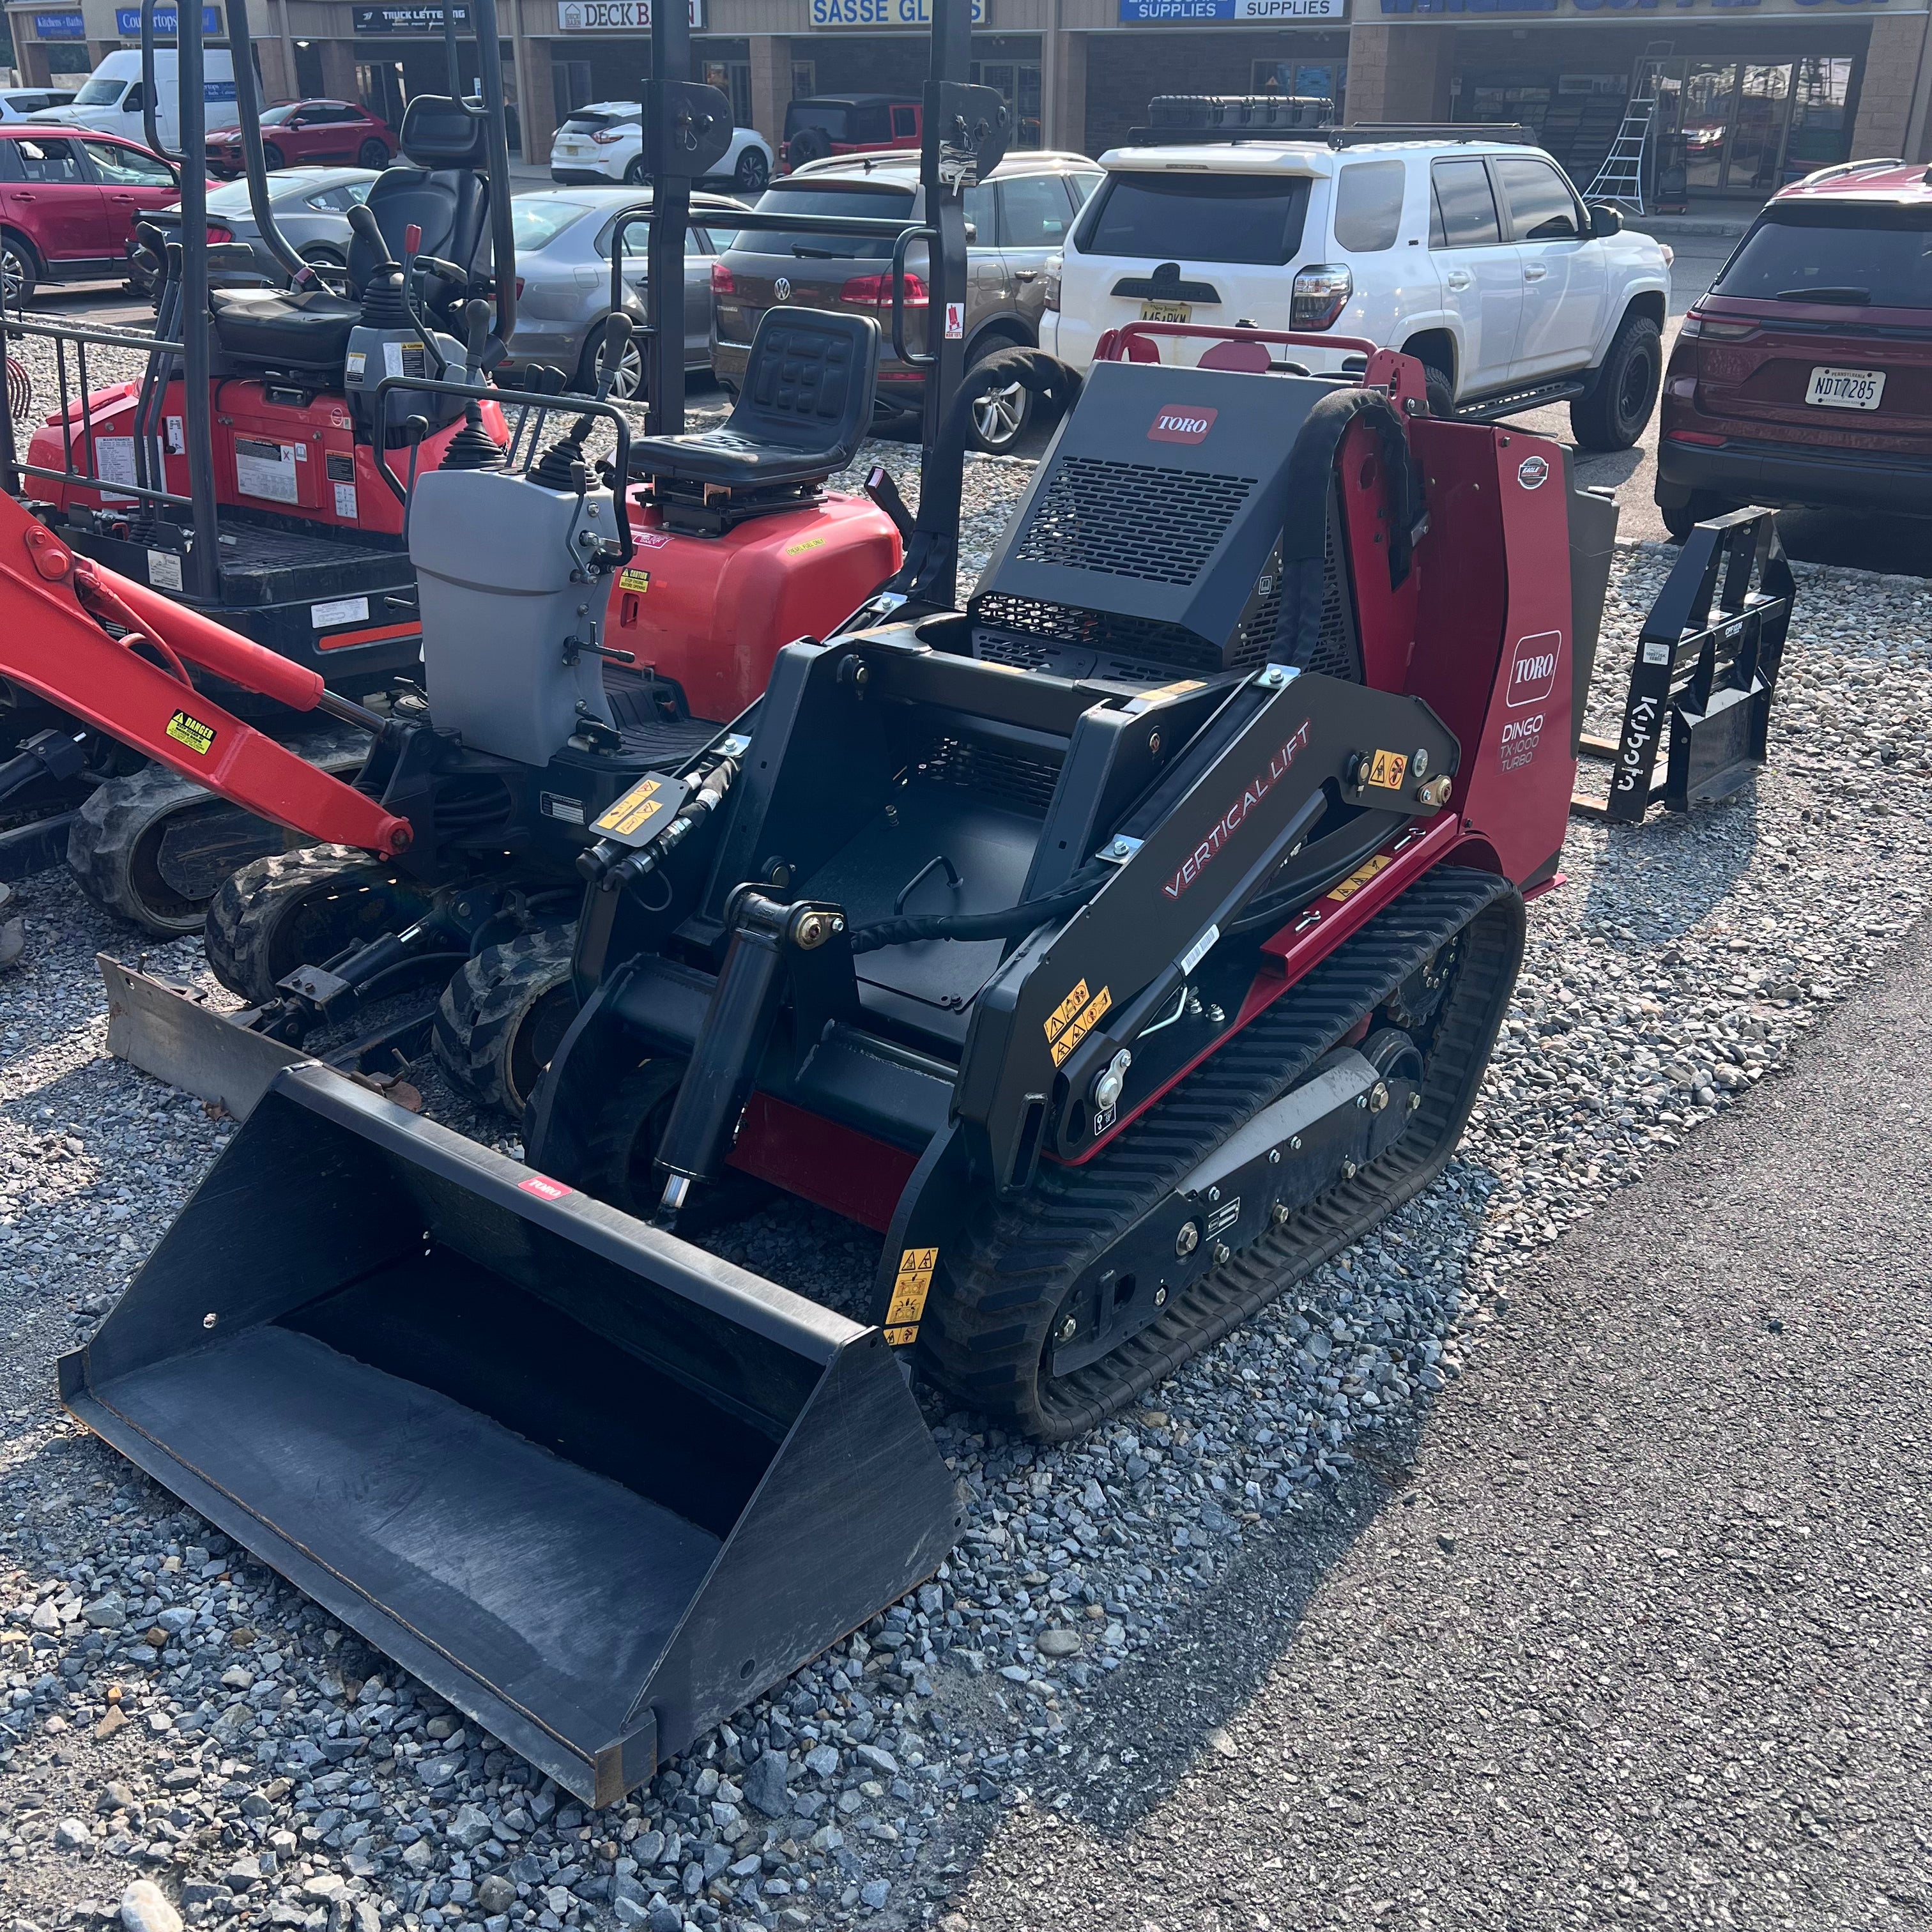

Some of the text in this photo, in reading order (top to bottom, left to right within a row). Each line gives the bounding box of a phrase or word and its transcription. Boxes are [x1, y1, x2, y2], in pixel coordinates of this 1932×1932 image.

[382, 10, 465, 20] TRUCK LETTENG
[584, 3, 634, 26] DECK
[813, 0, 981, 23] SASSE GLS
[1138, 3, 1216, 17] SUPPLIES
[1246, 1, 1330, 15] SUPPLIES
[122, 13, 178, 31] Courtops
[1815, 377, 1876, 399] NDT7285
[1158, 415, 1207, 433] TORO
[1515, 653, 1554, 684] TORO
[185, 717, 213, 739] DANGER
[1501, 714, 1544, 744] DINGO
[1617, 696, 1658, 791] Kubota
[1501, 751, 1533, 772] TURBO
[1164, 722, 1311, 898] VERTICAL LIFT
[528, 1179, 562, 1197] TORO
